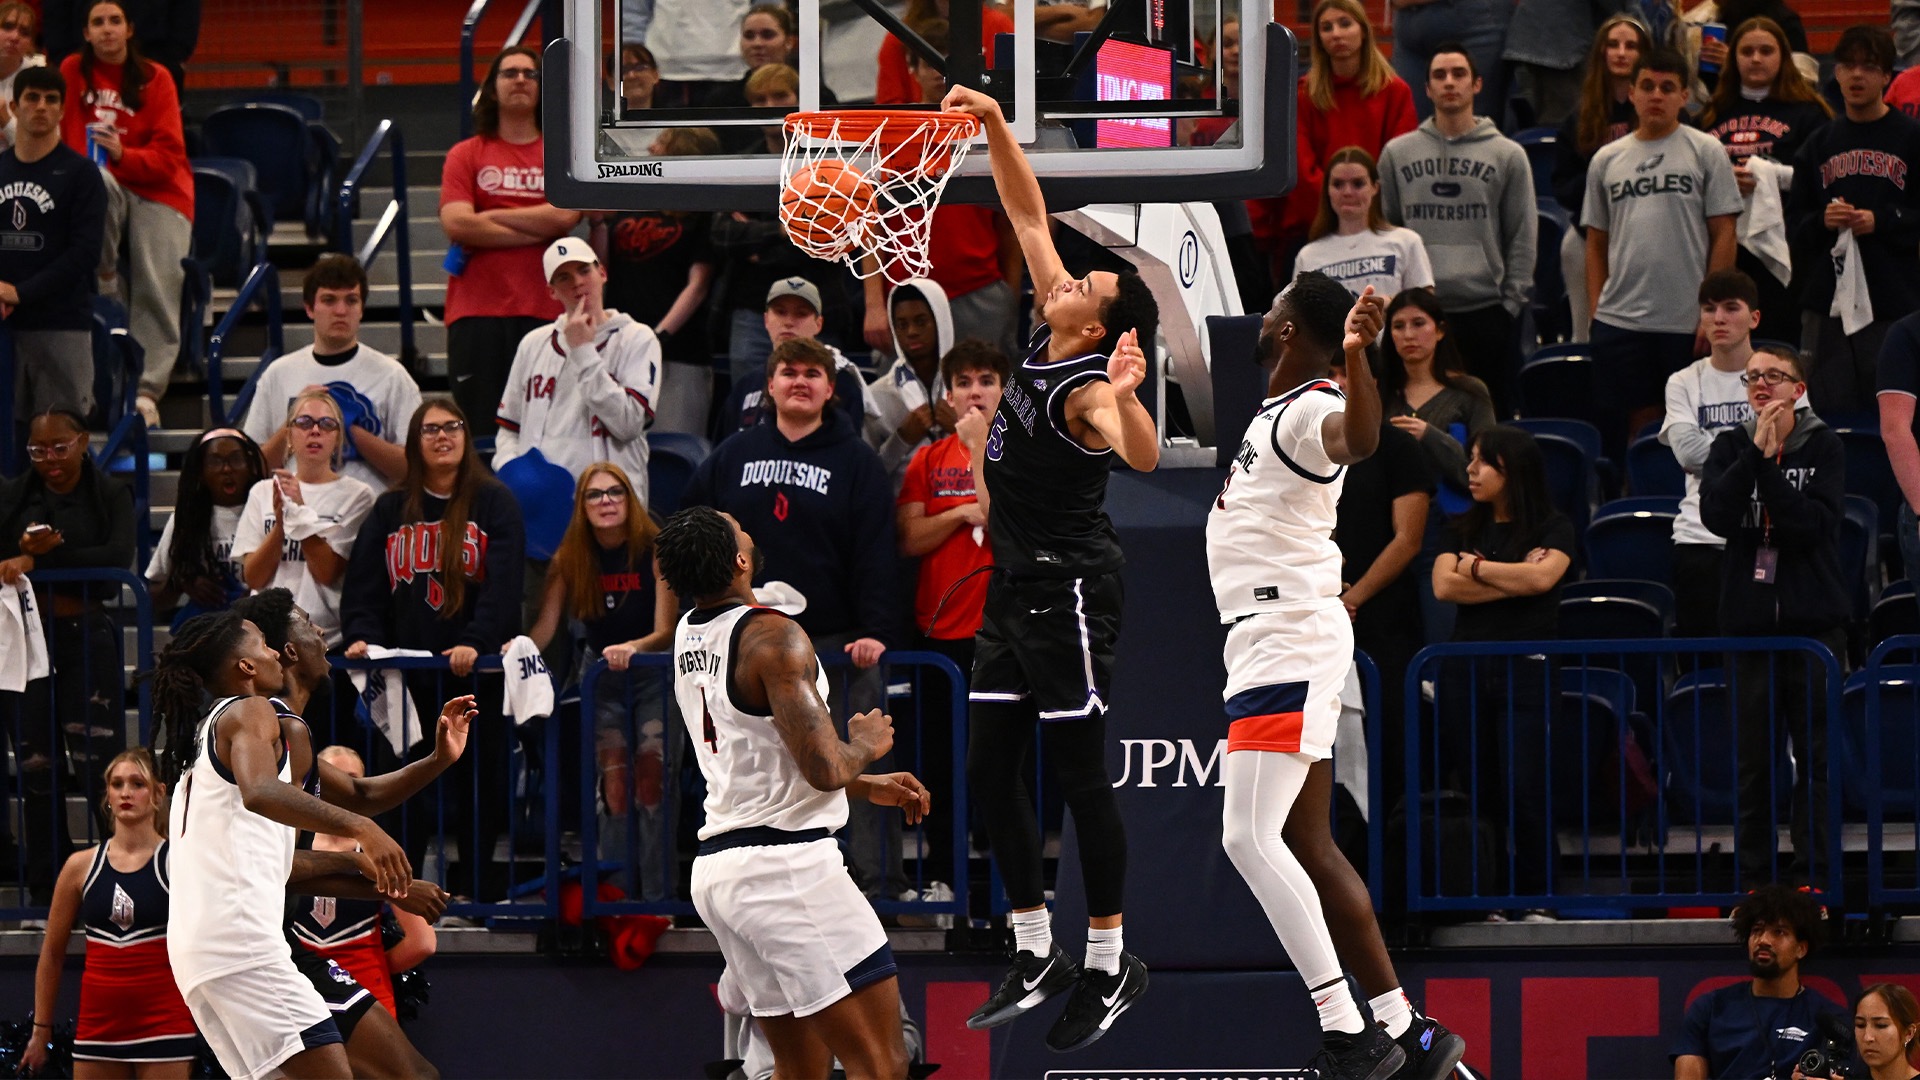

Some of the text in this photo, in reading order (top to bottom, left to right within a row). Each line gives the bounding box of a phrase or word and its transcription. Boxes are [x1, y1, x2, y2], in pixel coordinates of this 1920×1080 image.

[598, 162, 662, 179] SPALDING
[1610, 174, 1694, 202] EAGLES
[1405, 202, 1488, 222] UNIVERSITY
[700, 686, 718, 755] 4
